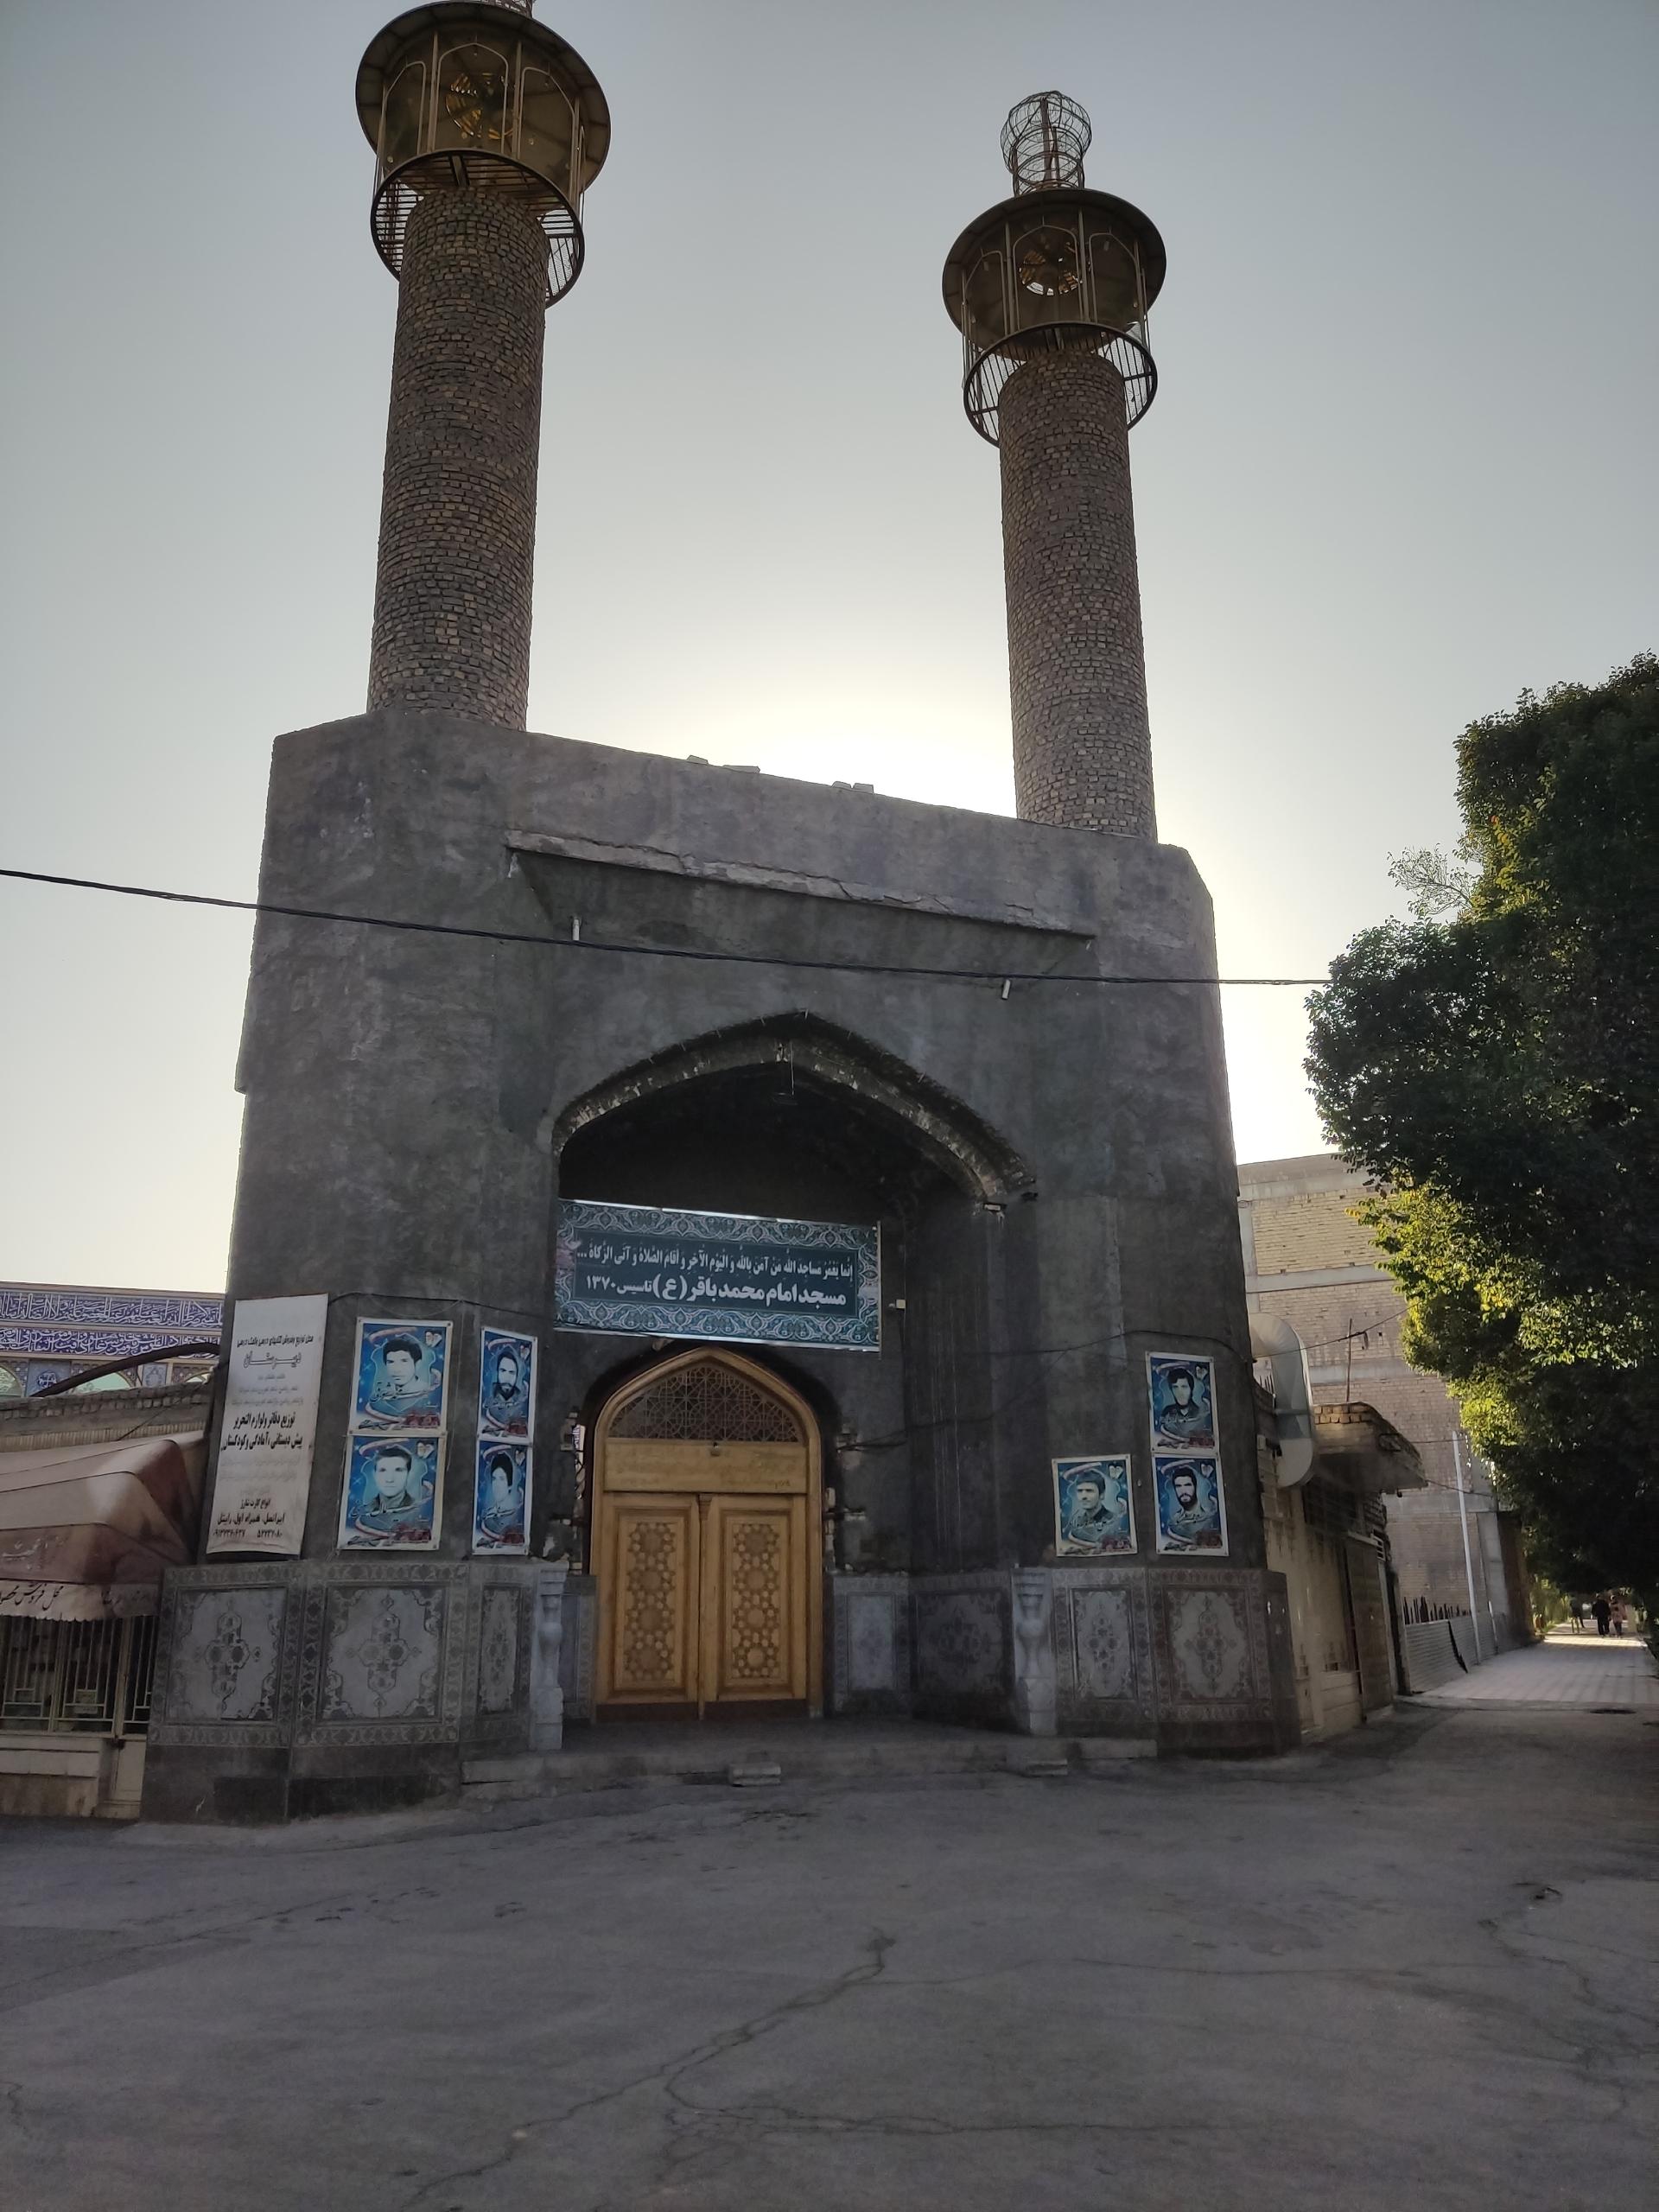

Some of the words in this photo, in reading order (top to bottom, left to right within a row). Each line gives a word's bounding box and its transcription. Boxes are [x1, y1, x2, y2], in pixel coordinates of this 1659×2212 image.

[586, 1274, 617, 1291] ۱۳۷۰
[686, 1274, 718, 1303] باقر
[718, 1282, 766, 1302] محمد
[766, 1281, 798, 1307] امام
[798, 1287, 847, 1310] مسجد
